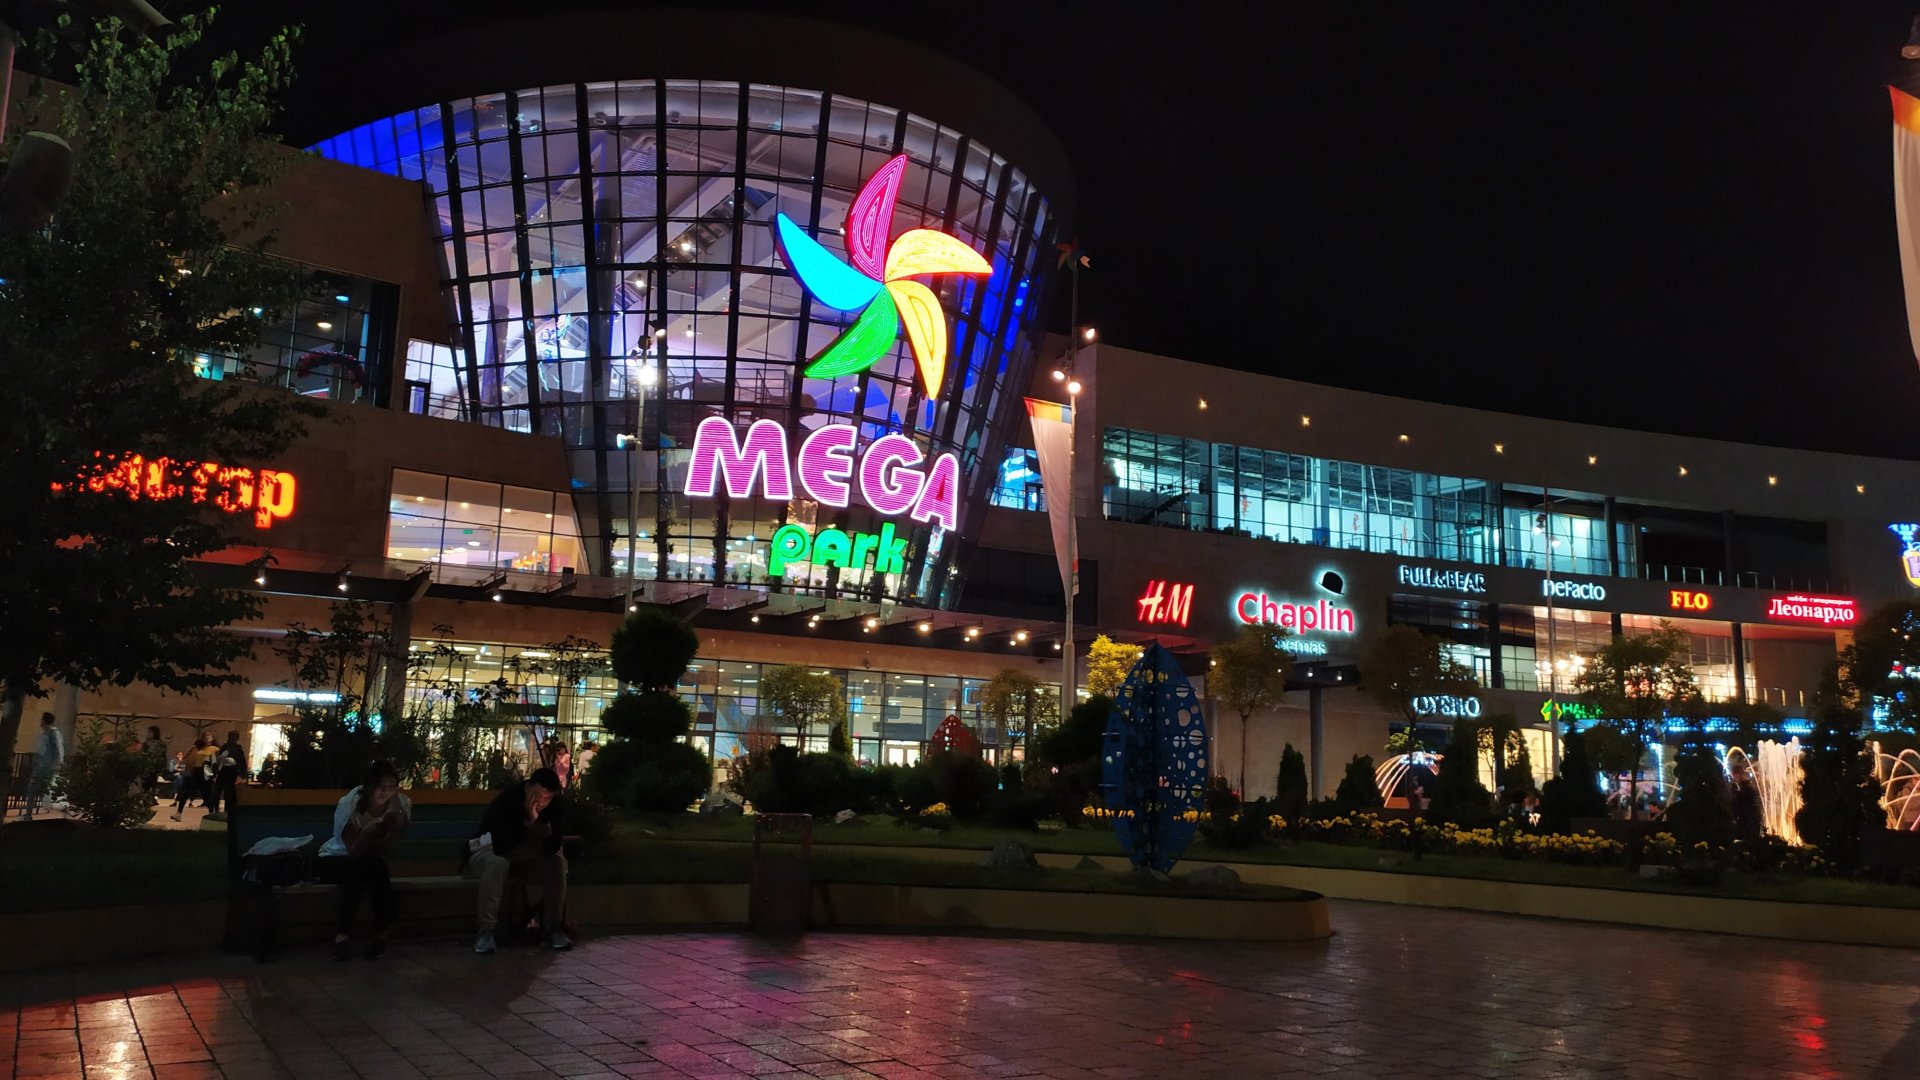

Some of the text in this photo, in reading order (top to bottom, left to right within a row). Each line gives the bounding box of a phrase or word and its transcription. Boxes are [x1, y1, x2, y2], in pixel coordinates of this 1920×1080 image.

[684, 416, 960, 531] MEGA
[1399, 565, 1487, 592] PULL&BEAR
[1543, 578, 1606, 602] DeFacto
[1138, 580, 1194, 627] H&M
[1670, 590, 1709, 609] FLO
[1768, 598, 1855, 623] Леонардо
[1237, 592, 1356, 635] Chaplin
